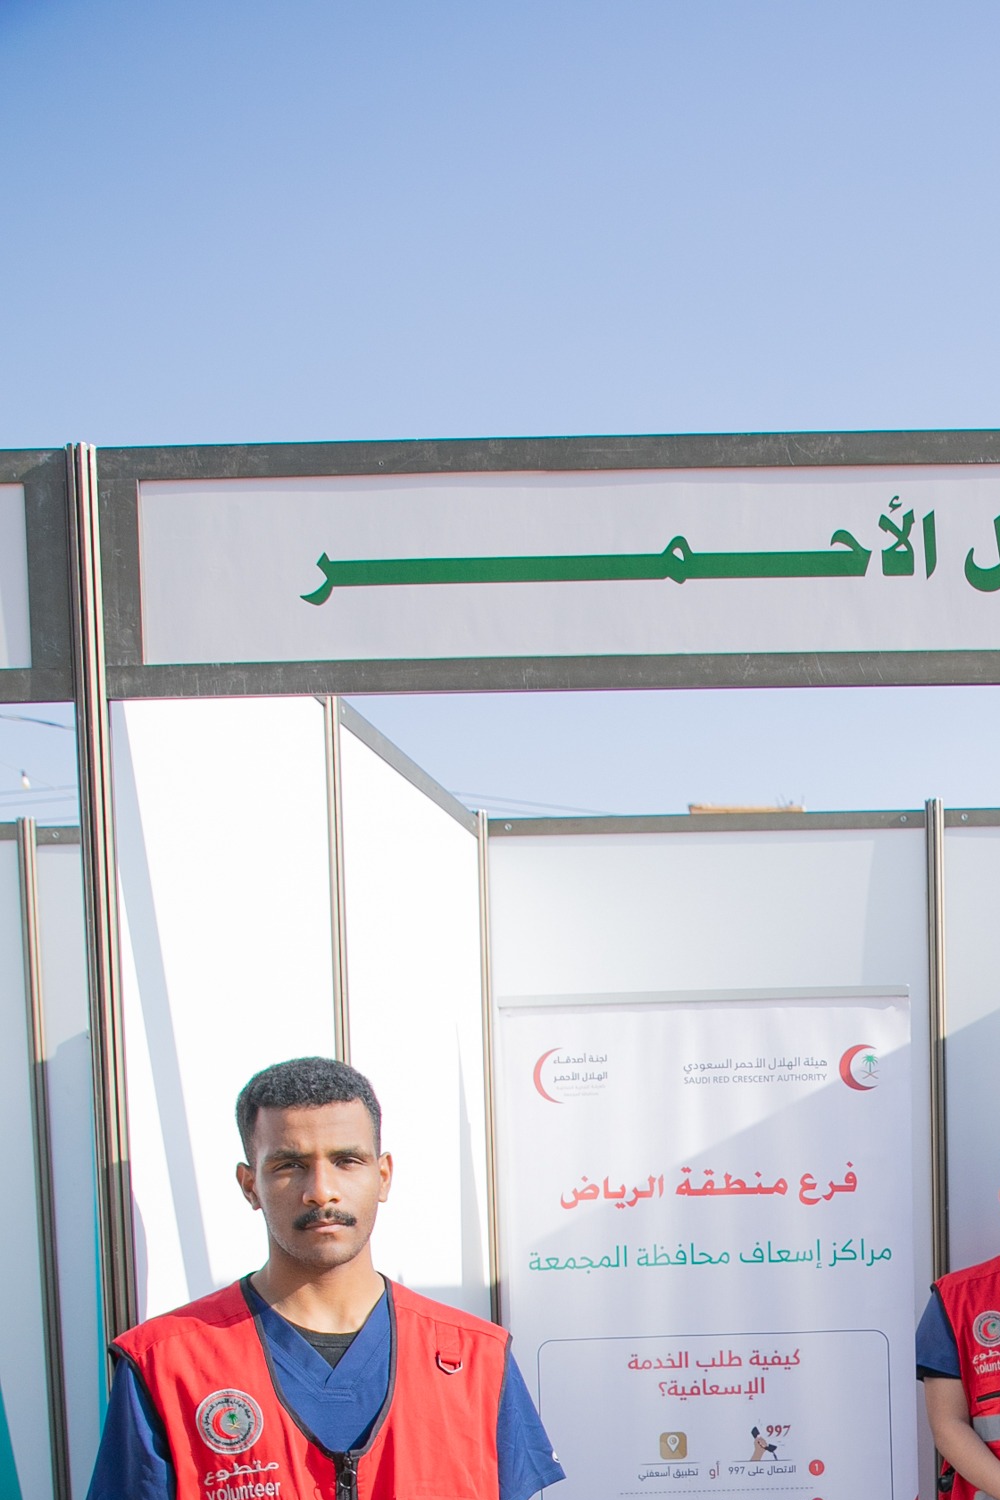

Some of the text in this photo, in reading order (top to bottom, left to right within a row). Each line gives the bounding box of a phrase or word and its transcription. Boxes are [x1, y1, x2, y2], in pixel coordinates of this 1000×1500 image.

[299, 494, 936, 607] الأحمر
[683, 1056, 828, 1075] هيئة الهلال الأحمر السعودي
[684, 1073, 828, 1085] SAUDI RED CRESCENT AUTHORITY
[560, 1161, 858, 1210] فرع منطقة الرياض
[529, 1238, 892, 1274] مراكز إسعاف محافظة المجمعة
[627, 1348, 801, 1373] كيفية طلب الخدمة
[658, 1377, 766, 1401] الإسعافية؟
[766, 1425, 791, 1438] 997
[204, 1459, 280, 1486] متطوع
[638, 1467, 699, 1480] تطبيق أسعفني
[708, 1461, 720, 1480] أو
[728, 1465, 797, 1477] الاتصال على 997
